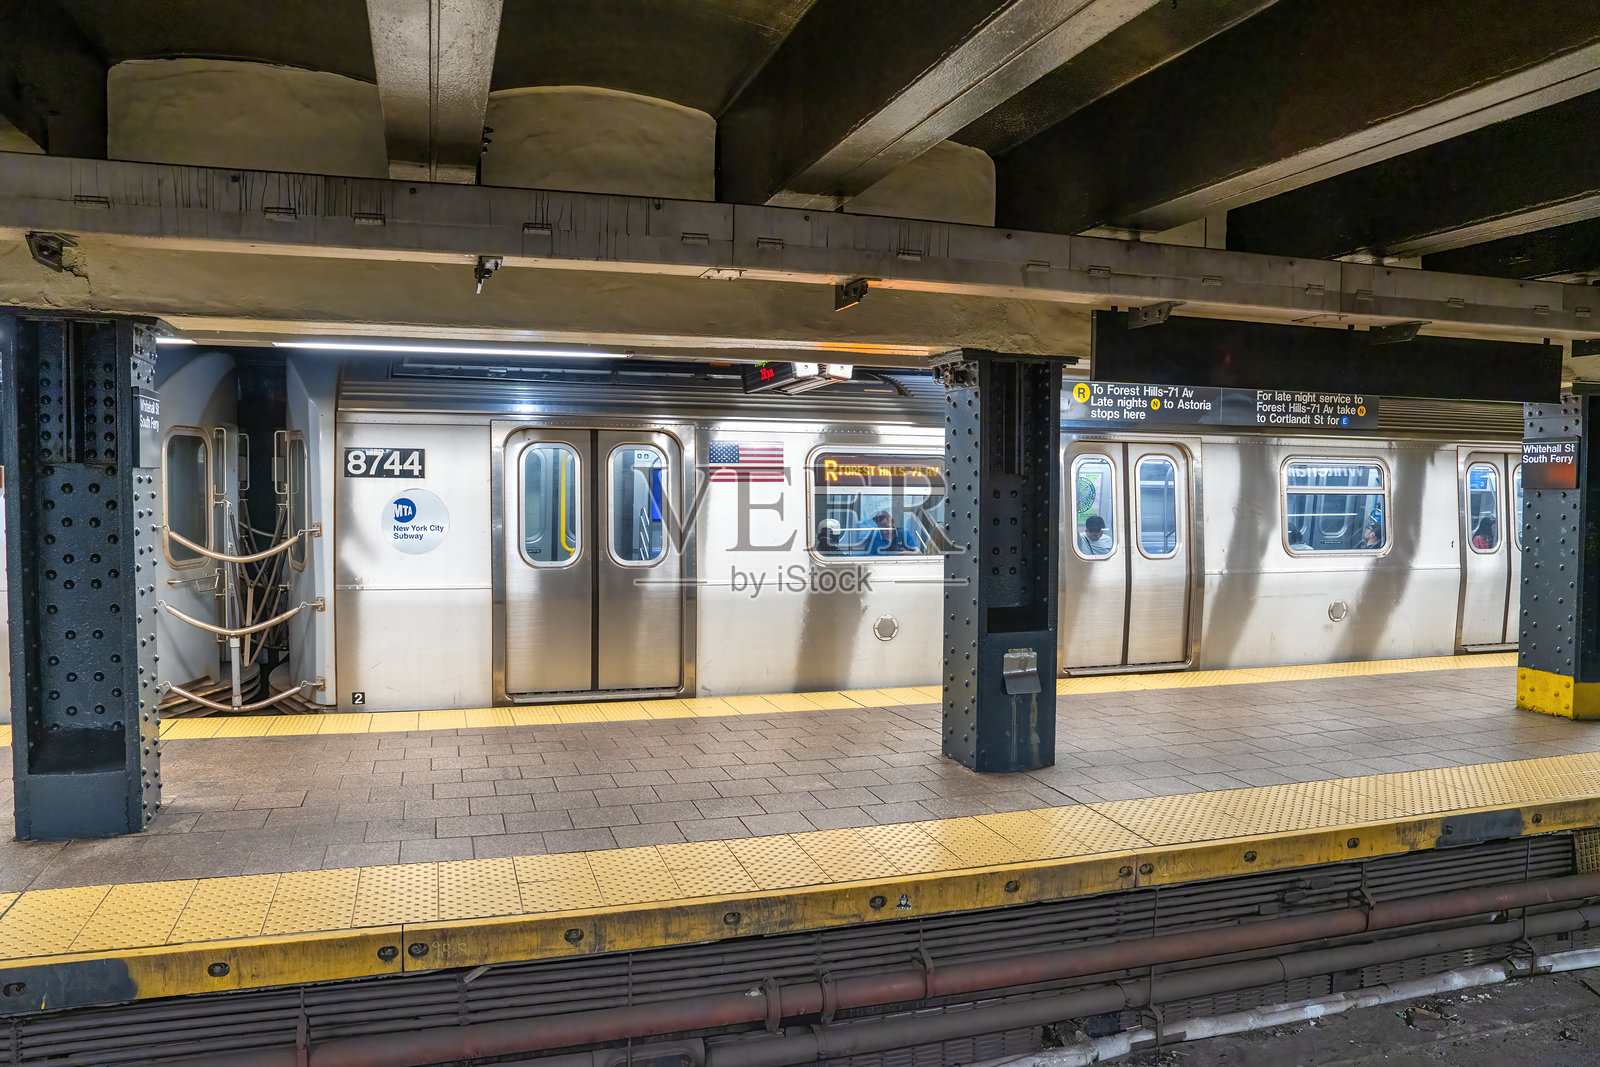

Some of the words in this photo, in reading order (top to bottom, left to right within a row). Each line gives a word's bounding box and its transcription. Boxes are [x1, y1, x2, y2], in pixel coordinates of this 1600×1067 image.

[1091, 384, 1103, 395] To
[1107, 385, 1139, 396] Forest
[1143, 386, 1179, 398] Hills-71
[1182, 387, 1193, 398] Av
[1090, 396, 1113, 407] Late
[1117, 397, 1147, 409] nights
[1164, 399, 1173, 409] to
[1177, 400, 1211, 410] Astoria
[1257, 390, 1272, 401] For
[1275, 391, 1291, 402] late
[1294, 392, 1316, 404] night
[1319, 393, 1351, 404] service
[1354, 395, 1363, 405] to
[1090, 409, 1120, 420] stops
[1123, 409, 1146, 419] here
[1256, 402, 1285, 412] Forest
[1288, 403, 1320, 413] Hills-71
[1323, 404, 1334, 414] Av
[1337, 405, 1356, 415] take
[1256, 413, 1266, 423] to
[1269, 413, 1311, 425] Cortlandt
[1314, 415, 1324, 425] St
[1327, 415, 1340, 425] for
[1523, 444, 1562, 453] Whitehall
[1564, 443, 1575, 453] St
[347, 450, 422, 476] 8744
[1522, 454, 1548, 463] South
[1550, 454, 1574, 465] Ferry
[824, 459, 838, 481] R
[839, 465, 876, 477] FOREST
[392, 502, 413, 518] MTA
[429, 524, 444, 533] City
[393, 532, 424, 541] Subway
[354, 693, 363, 704] 2
